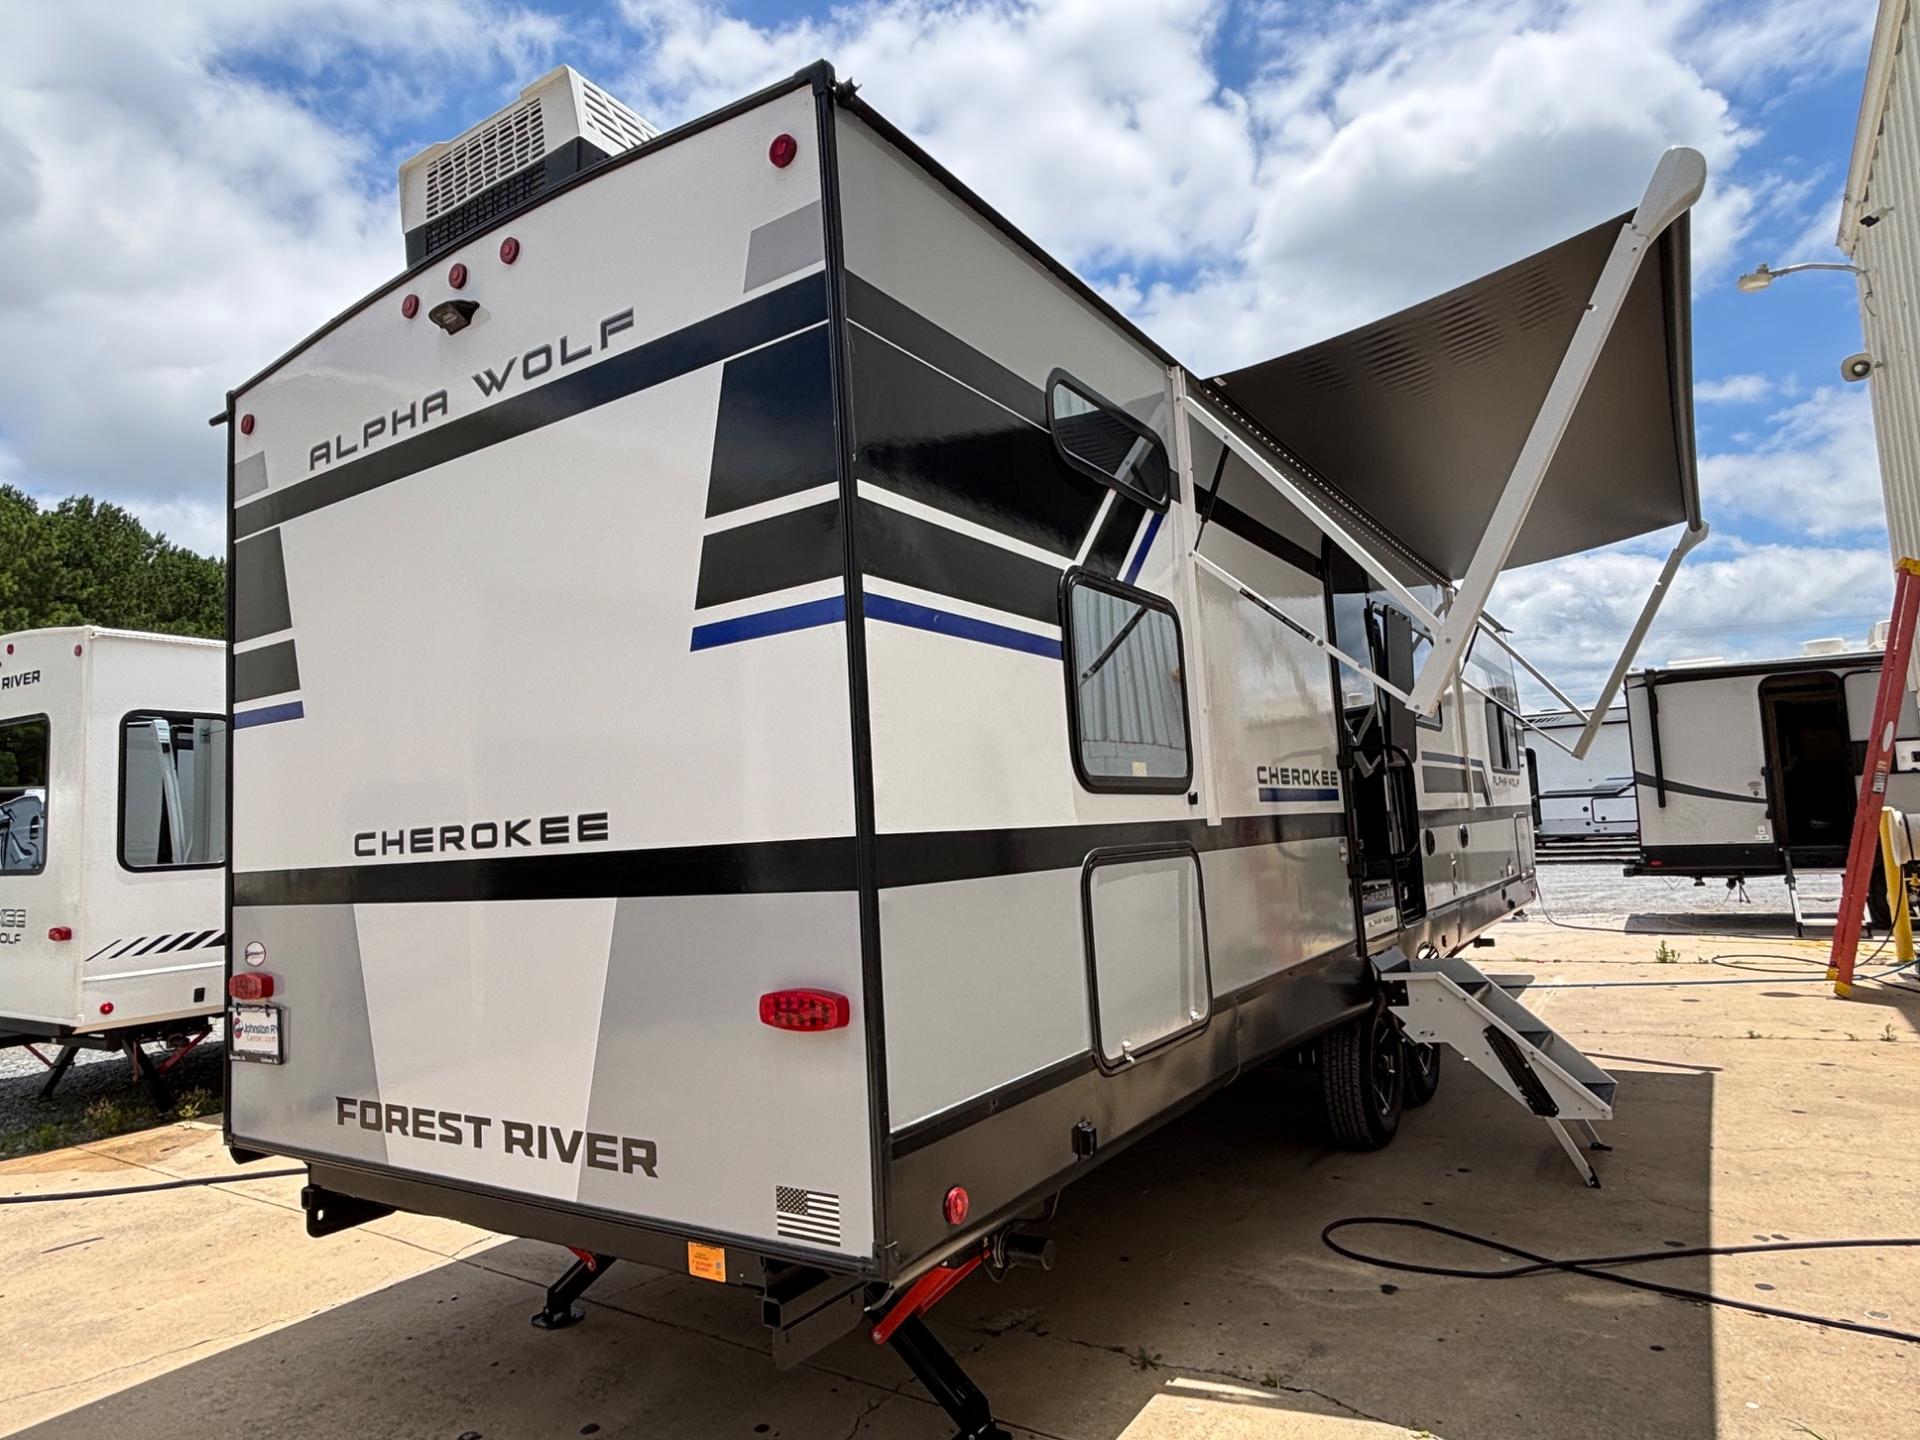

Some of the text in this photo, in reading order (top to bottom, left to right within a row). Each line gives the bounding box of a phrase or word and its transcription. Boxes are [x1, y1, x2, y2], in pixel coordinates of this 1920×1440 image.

[309, 306, 635, 472] ALPHA WOLF
[1, 669, 41, 690] RIVER
[1257, 766, 1339, 787] CHEROKEE
[354, 811, 609, 858] CHEROKEE
[0, 932, 21, 945] OLF
[244, 1023, 269, 1034] Johnston
[335, 1096, 659, 1179] FOREST RIVER
